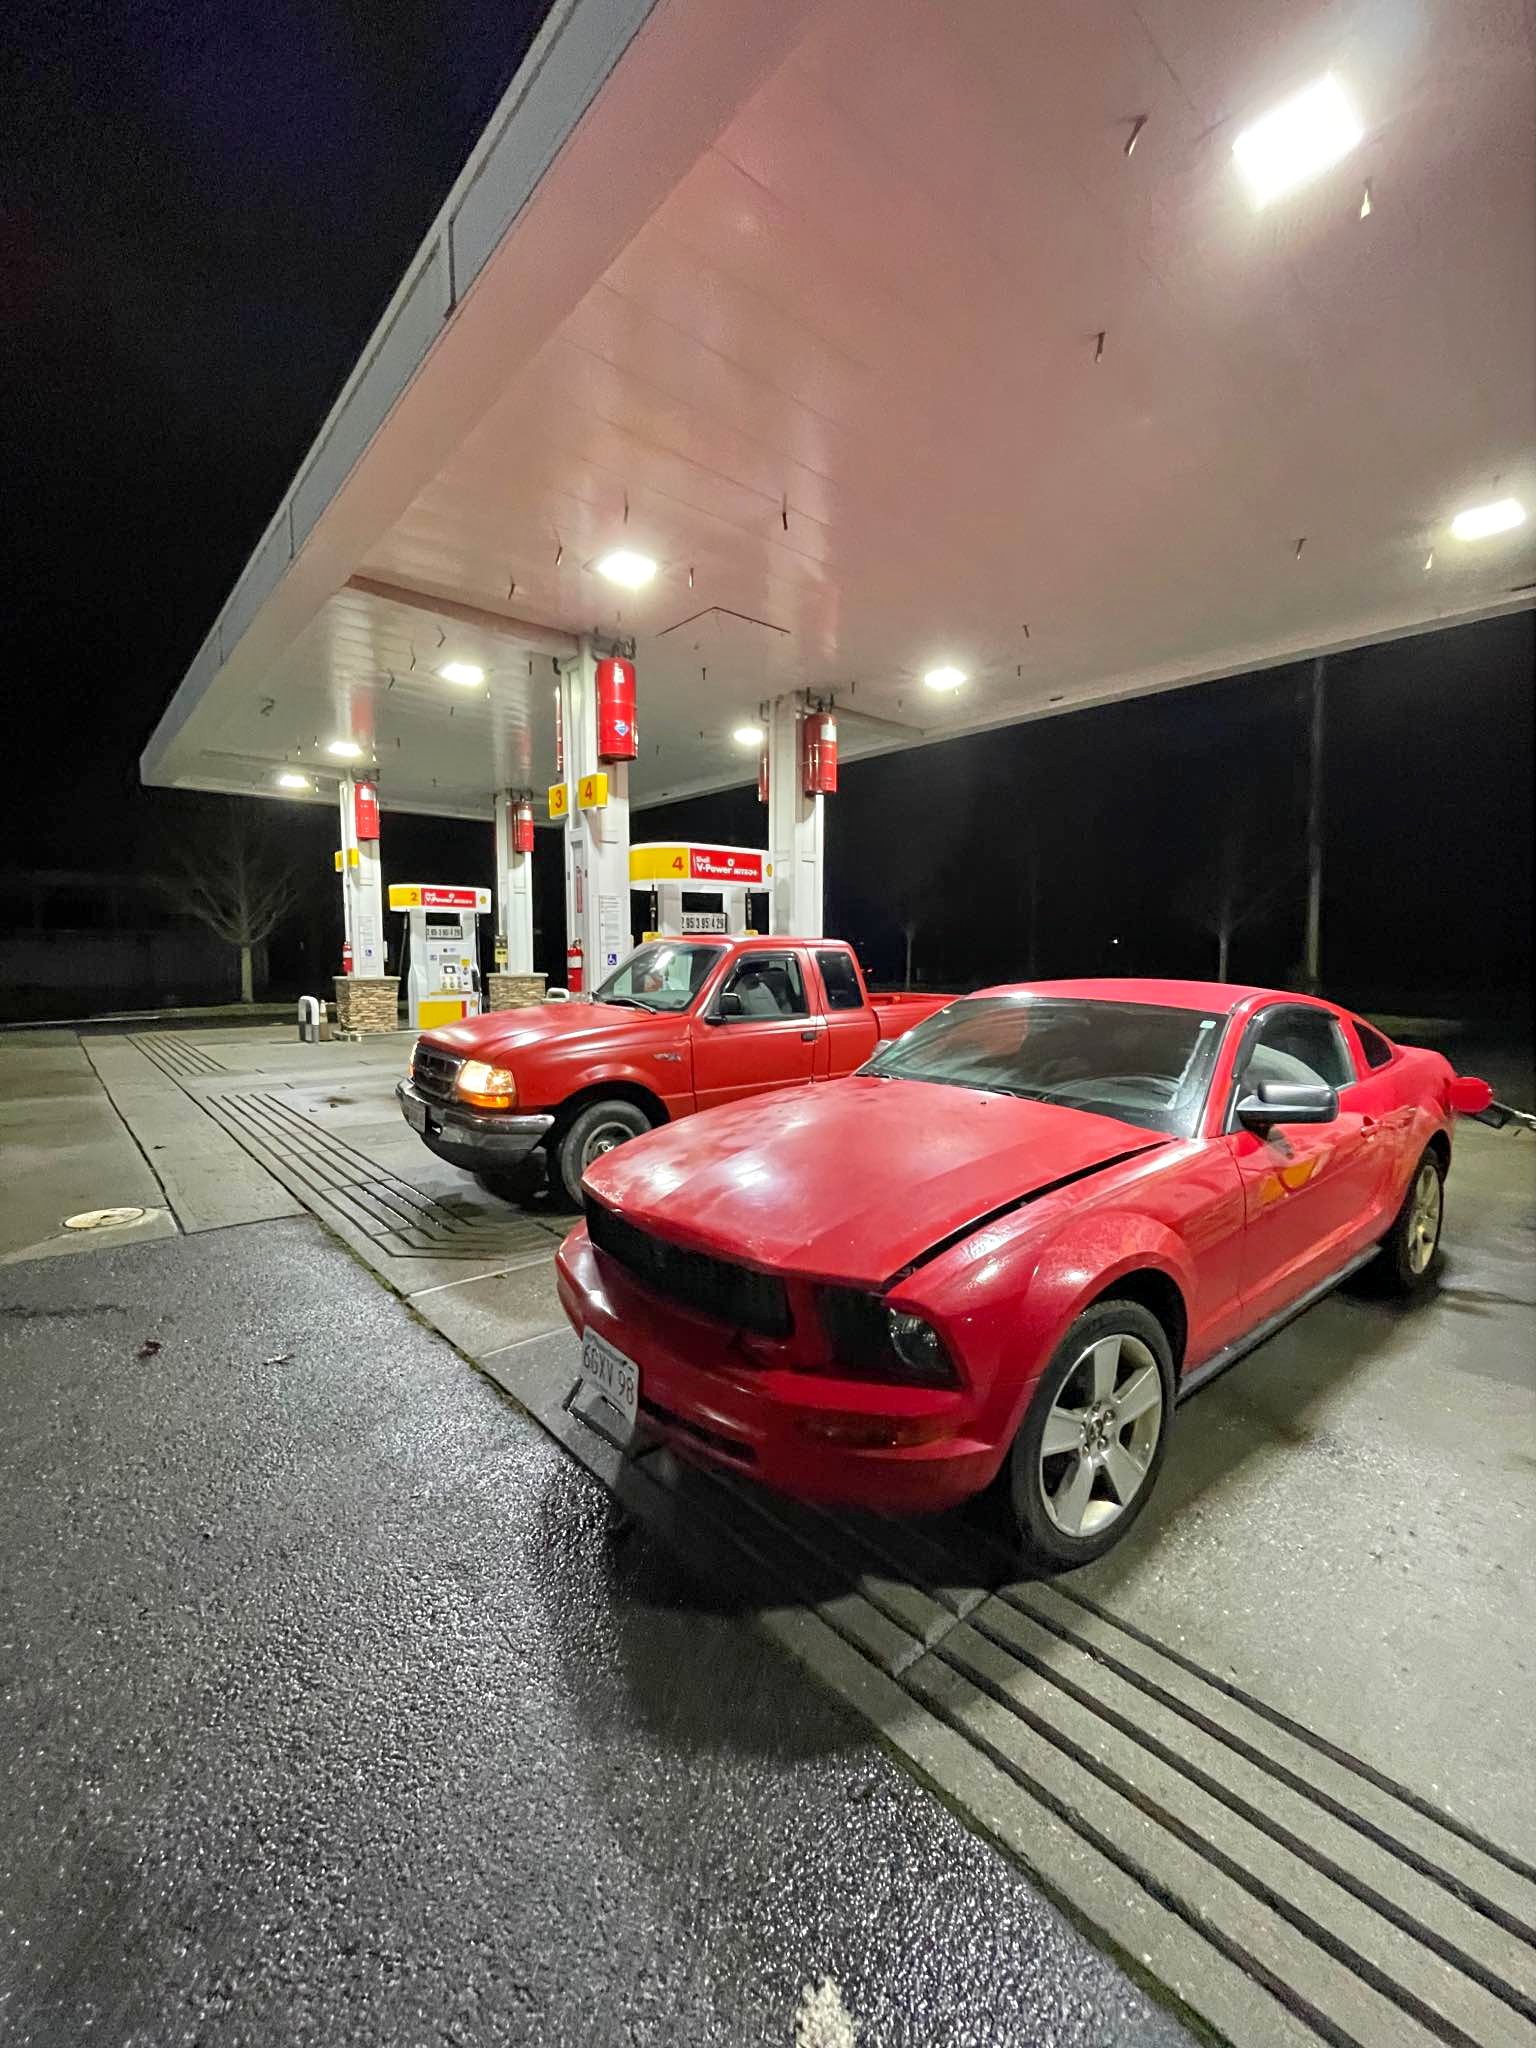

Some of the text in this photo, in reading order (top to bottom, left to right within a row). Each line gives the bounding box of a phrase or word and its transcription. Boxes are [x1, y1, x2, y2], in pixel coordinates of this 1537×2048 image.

[555, 789, 563, 809] 3
[584, 780, 593, 801] 4
[671, 855, 685, 873] 4
[696, 862, 733, 875] V-Power
[410, 891, 418, 902] 2
[619, 1370, 634, 1406] 98
